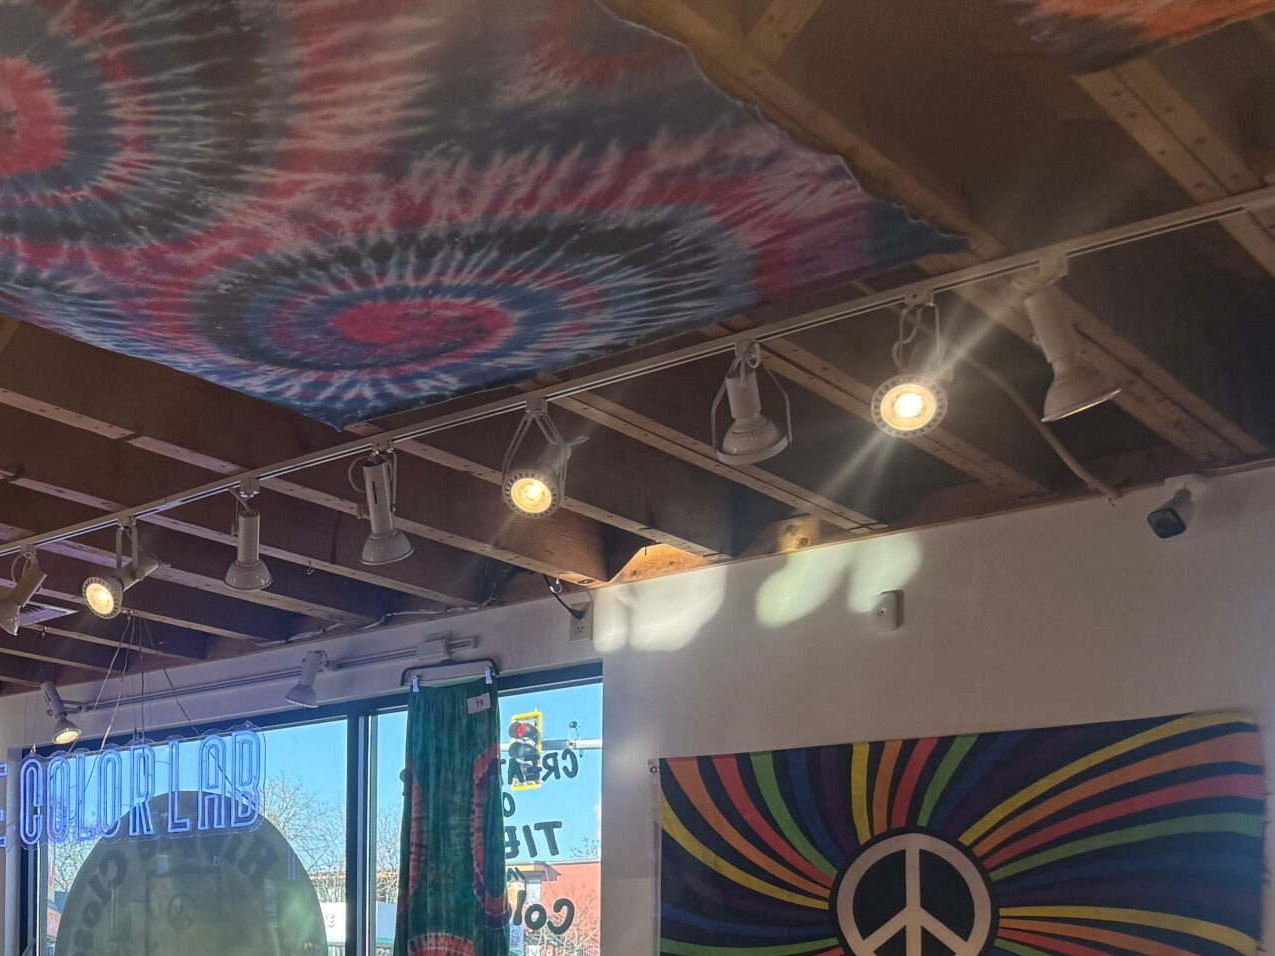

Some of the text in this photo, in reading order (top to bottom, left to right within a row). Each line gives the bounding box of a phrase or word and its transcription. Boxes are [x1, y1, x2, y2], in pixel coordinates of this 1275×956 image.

[475, 698, 484, 708] 19
[20, 743, 156, 846] COLOR
[167, 730, 262, 834] LAB
